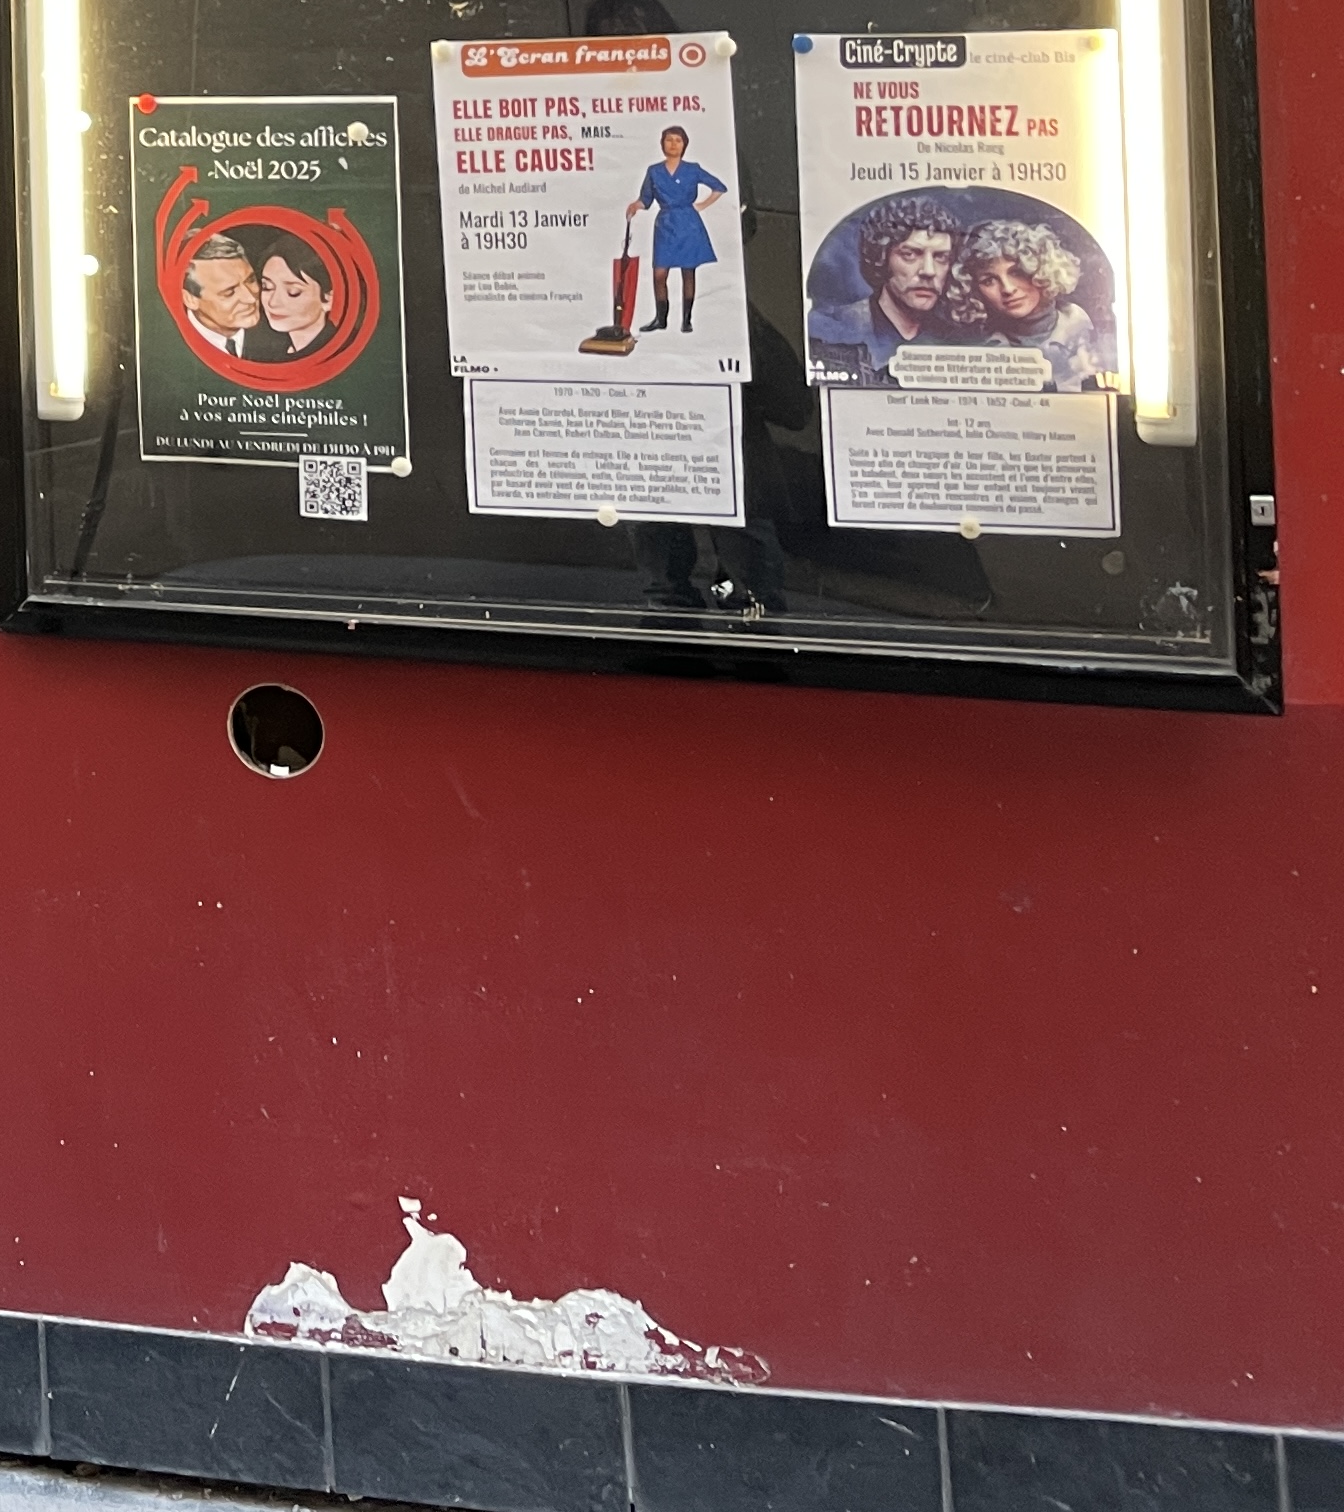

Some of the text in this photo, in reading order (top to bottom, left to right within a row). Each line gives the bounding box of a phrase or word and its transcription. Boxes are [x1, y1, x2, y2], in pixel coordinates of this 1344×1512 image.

[575, 43, 668, 66] français
[845, 39, 957, 67] Ciné-Crypte
[853, 81, 919, 99] NE VOUS
[452, 96, 706, 120] ELLE BOIT PAS, ELLE FUME PAS,
[855, 105, 1059, 137] RETOURNEZ PAS
[139, 126, 252, 153] Catalogue
[256, 126, 295, 147] des
[454, 127, 482, 142] ELLE
[486, 126, 537, 141] DRAGUE
[542, 125, 573, 141] PAS,
[456, 147, 594, 174] ELLE CAUSE!
[208, 159, 321, 182] Noël 2025
[850, 162, 1067, 181] Jeudi 15 Janvier à 19H30
[459, 182, 547, 195] de Michel Audiard
[459, 210, 589, 228] Mardi 13 Janvier
[461, 232, 527, 250] à 19H30
[198, 393, 343, 411] Pour Noël pensez
[180, 409, 189, 421] à
[193, 410, 222, 422] vos
[227, 411, 266, 424] amis
[271, 410, 358, 428] cinéphiles
